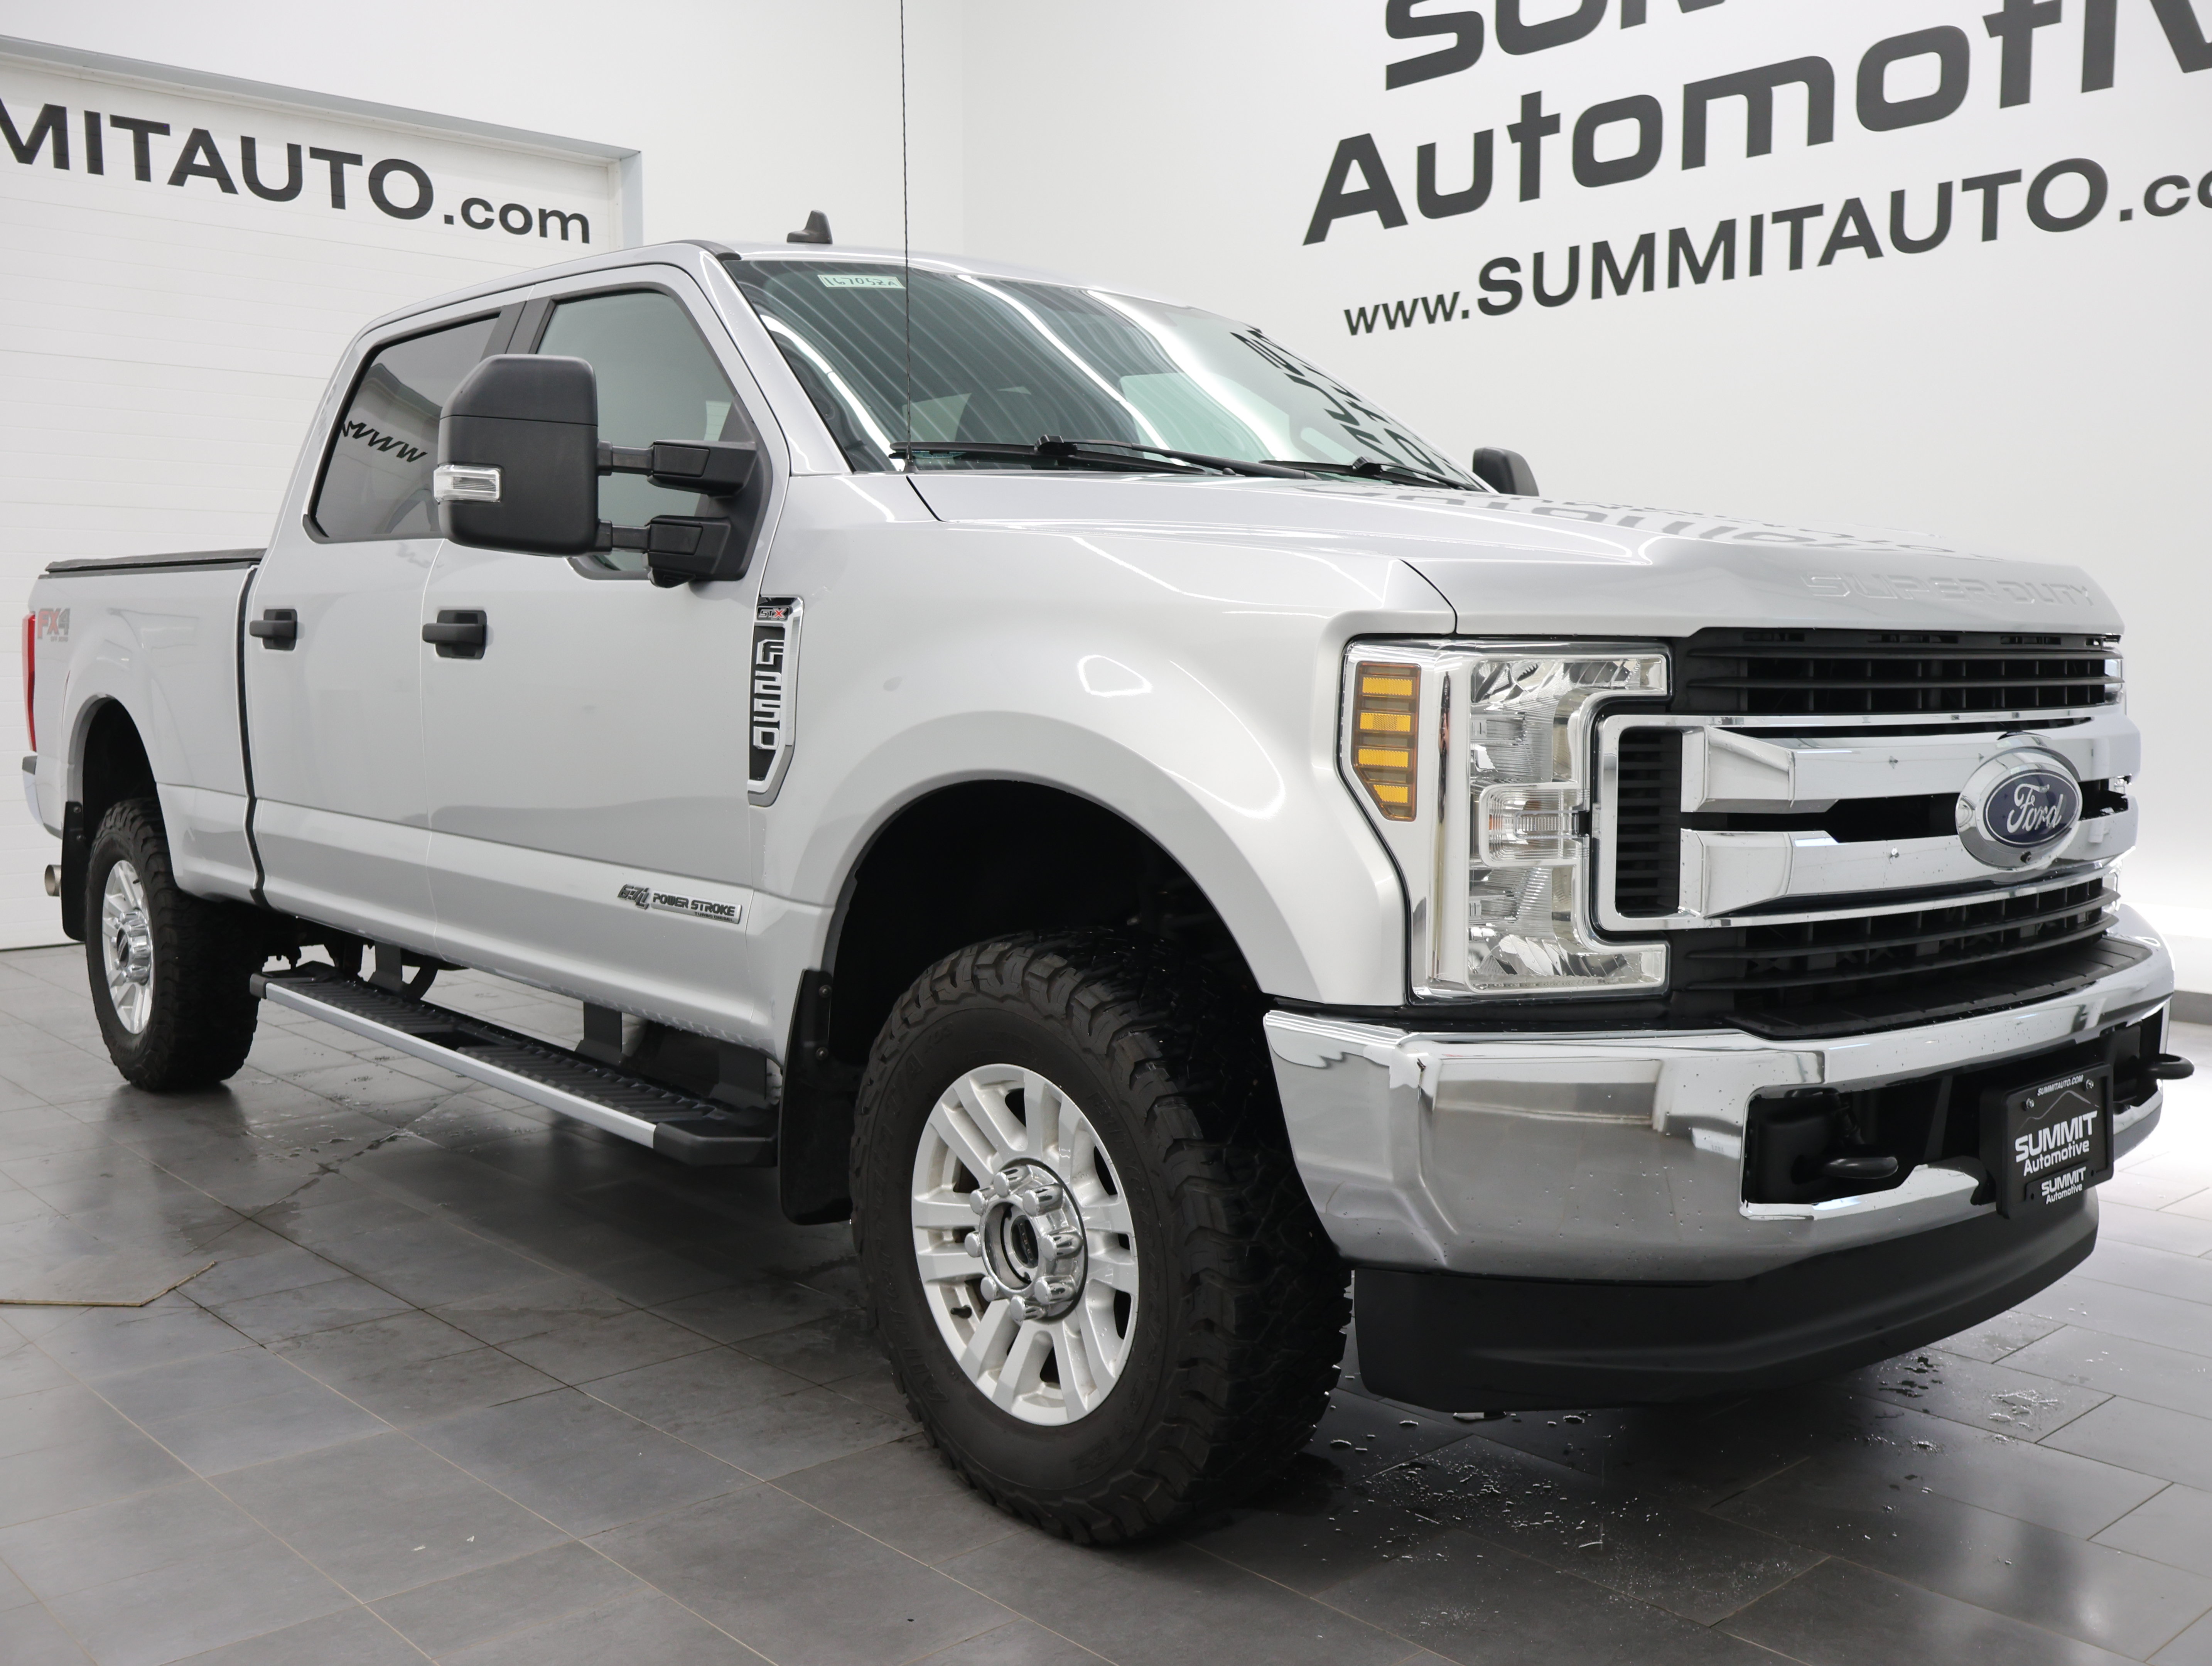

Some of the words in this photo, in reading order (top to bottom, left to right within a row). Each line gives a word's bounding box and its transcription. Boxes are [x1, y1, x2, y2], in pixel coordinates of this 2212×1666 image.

[1801, 573, 1996, 603] SUPER
[1997, 580, 2094, 606] DUTY
[37, 608, 70, 639] FX4
[758, 608, 787, 620] STX
[2007, 783, 2064, 833] Ford
[653, 892, 688, 909] POWER
[690, 899, 736, 917] STROKE
[2037, 1074, 2084, 1096] SUMMITAUTO.COM
[2015, 1111, 2097, 1163] SUMMIT
[2023, 1140, 2089, 1177] Automotive
[2041, 1167, 2086, 1196] SUMMIT
[2046, 1184, 2082, 1205] Automotive
